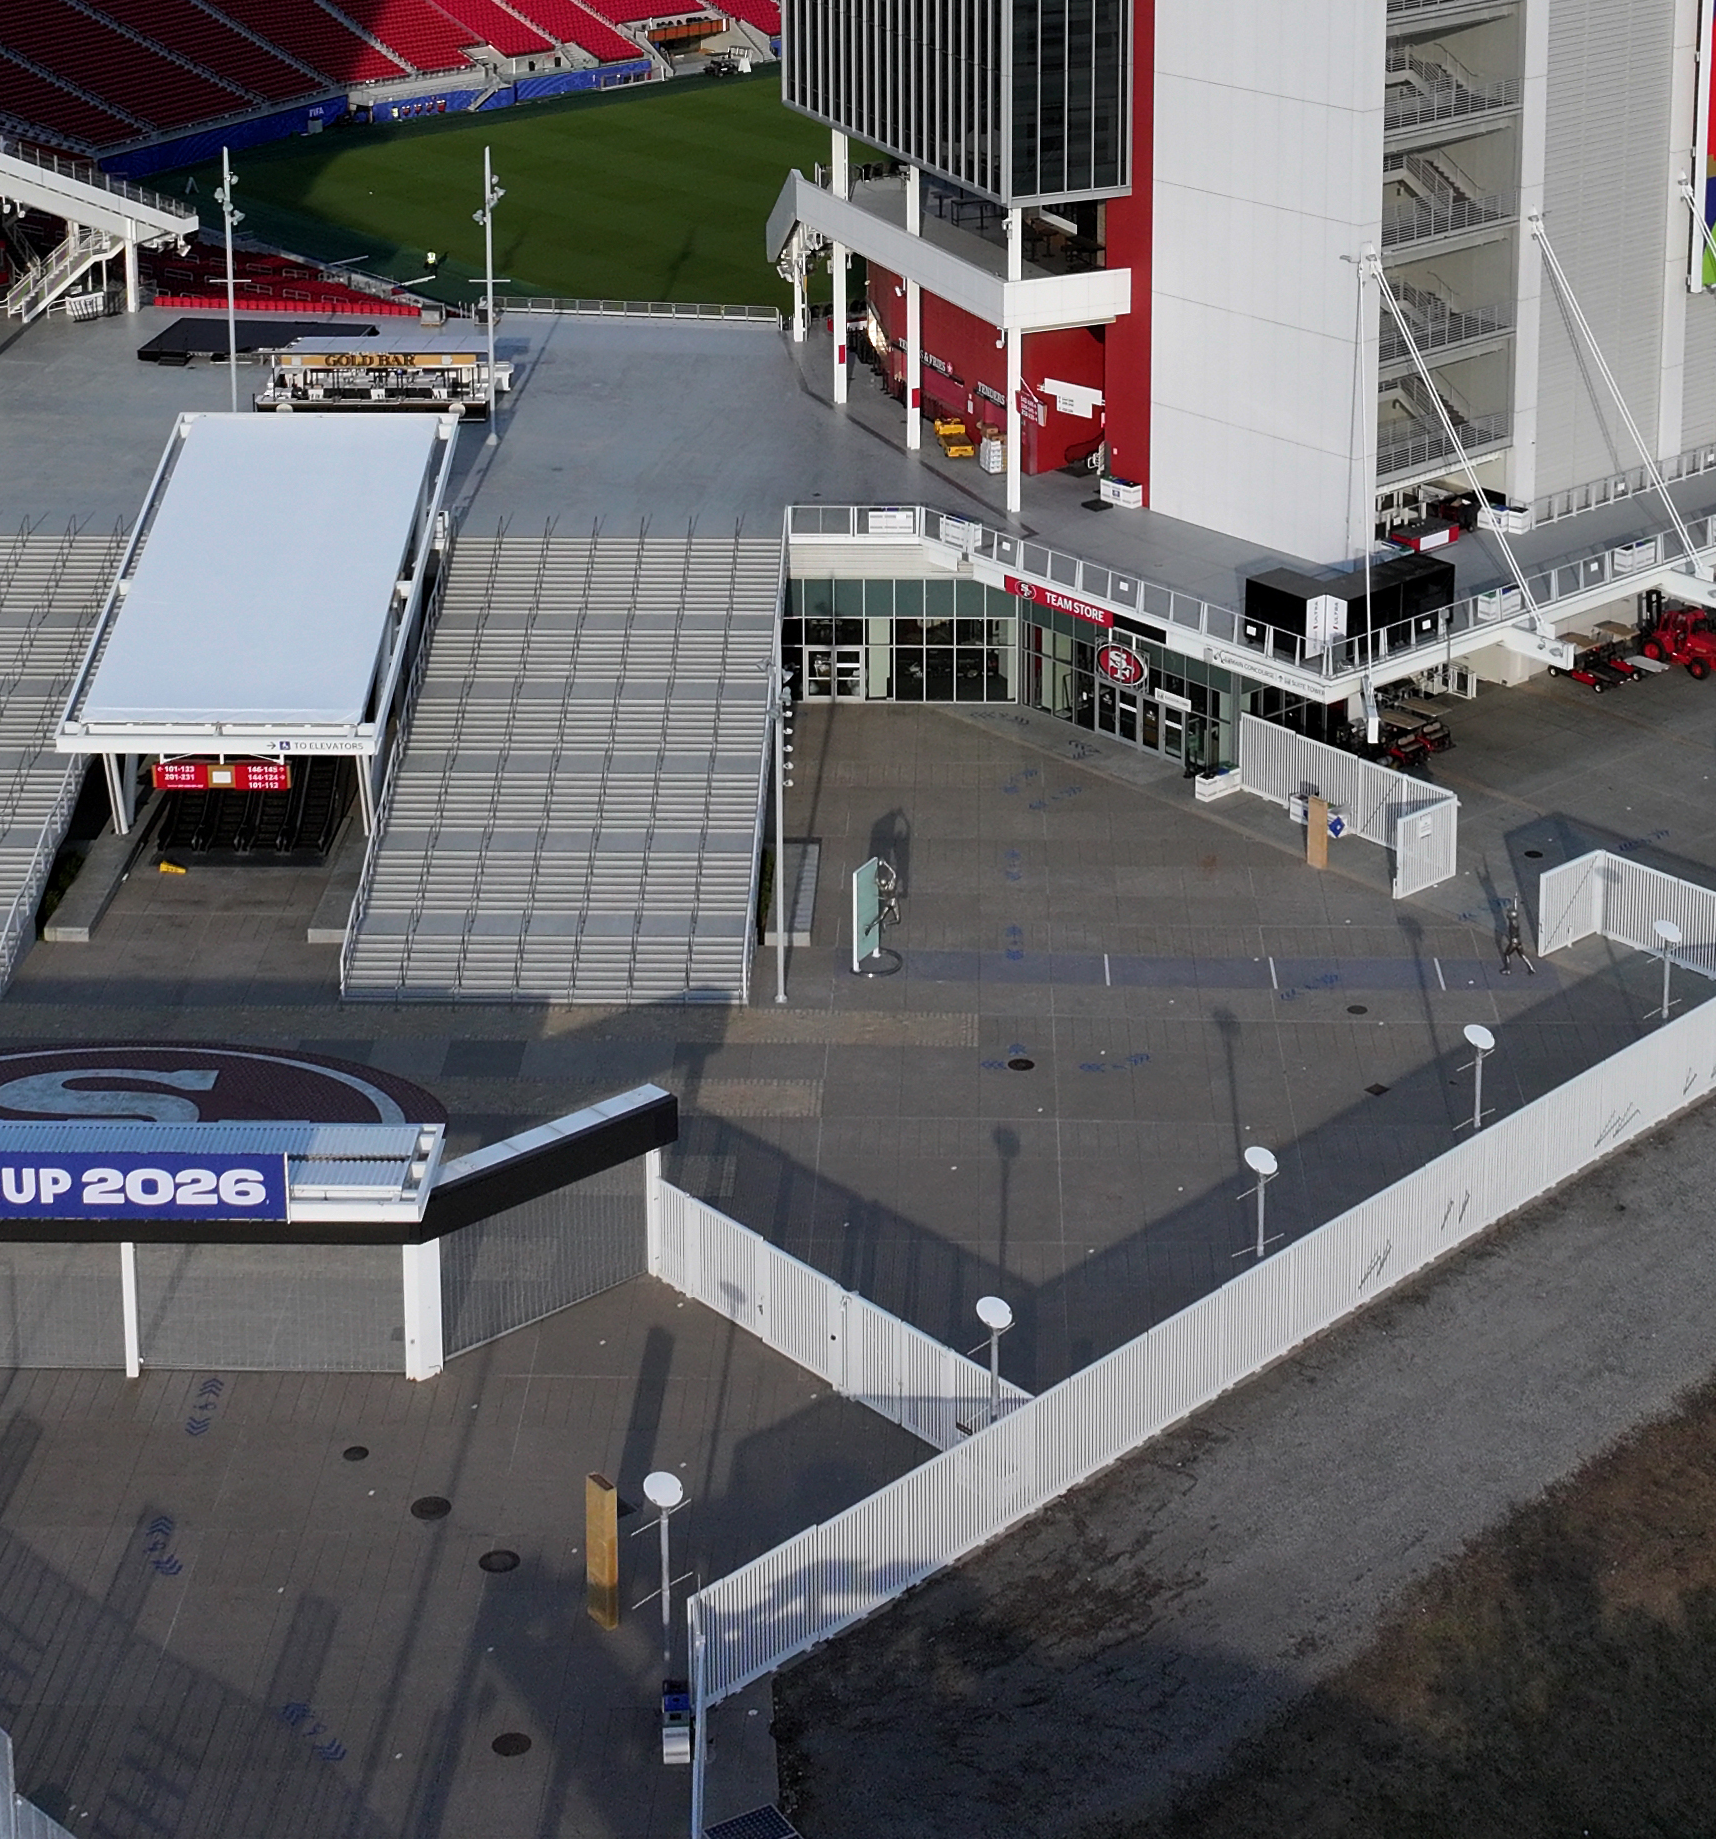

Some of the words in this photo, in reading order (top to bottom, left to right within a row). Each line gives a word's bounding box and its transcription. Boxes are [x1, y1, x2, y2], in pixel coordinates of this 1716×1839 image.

[309, 106, 324, 119] FIFA
[325, 354, 375, 368] GOLD
[378, 354, 416, 368] BAR
[977, 381, 1006, 405] TENDERS
[1045, 591, 1073, 612] TEAM
[1073, 602, 1105, 623] STORE
[294, 741, 308, 751] TO
[309, 741, 364, 751] ELEVATORS
[81, 1168, 267, 1205] 2026
